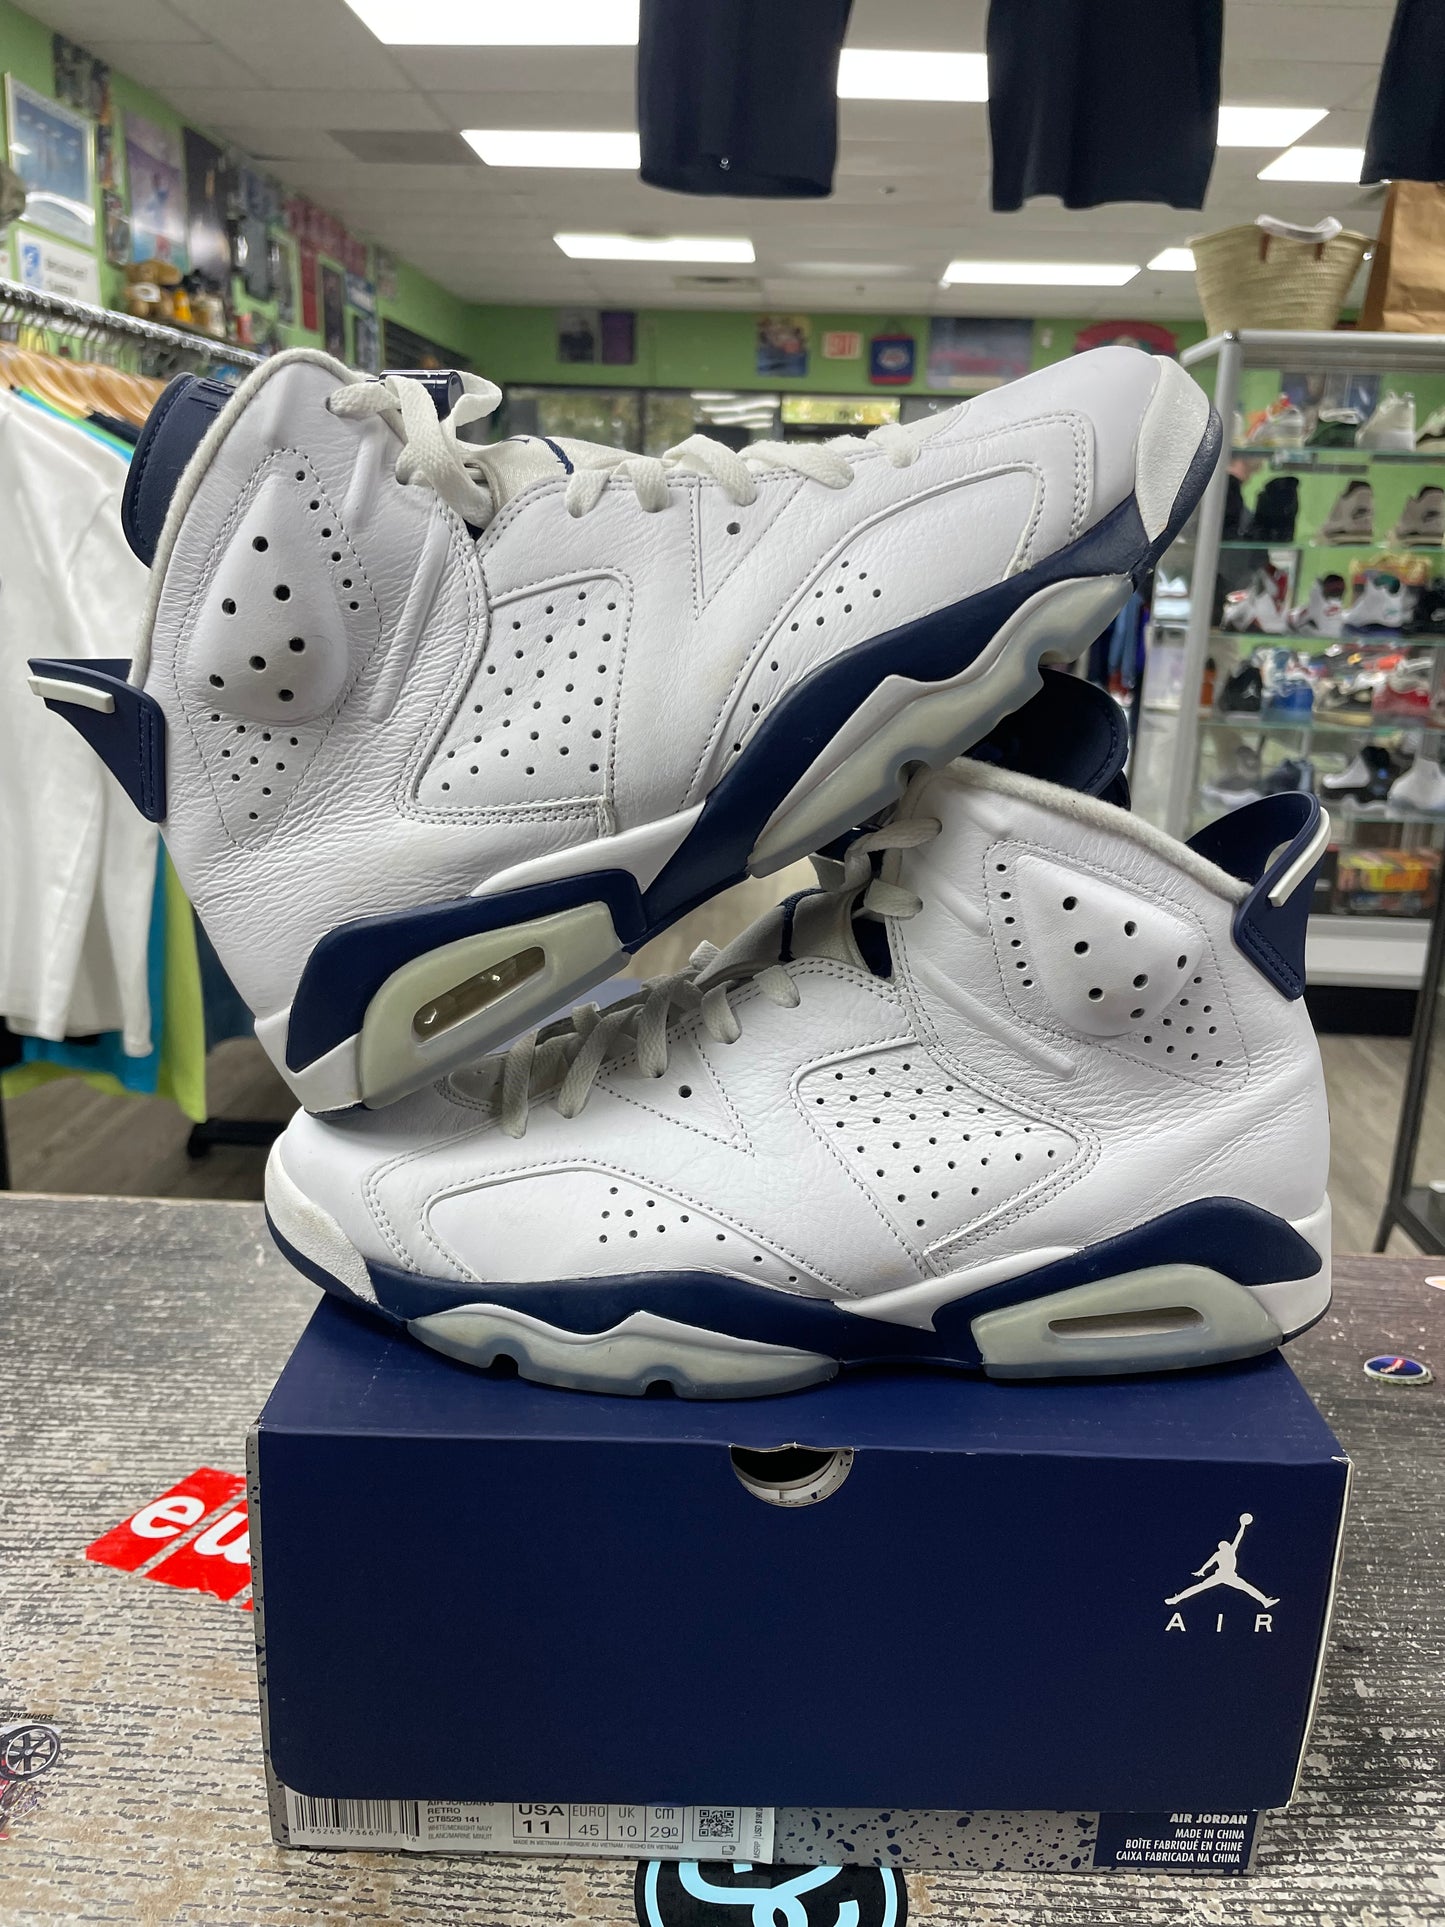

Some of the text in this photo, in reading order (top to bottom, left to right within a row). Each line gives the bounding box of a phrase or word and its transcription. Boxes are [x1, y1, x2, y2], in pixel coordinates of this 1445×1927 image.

[1165, 1612, 1273, 1633] AIR
[427, 1807, 461, 1815] RETRO
[518, 1804, 565, 1816] USA
[572, 1805, 606, 1818] EURO
[618, 1807, 635, 1819] UK
[655, 1808, 674, 1820] cm
[427, 1815, 462, 1823] CT8529
[1169, 1813, 1248, 1825] AIR JORDAN
[522, 1820, 550, 1834] 11
[578, 1824, 600, 1836] 45
[617, 1825, 637, 1837] 10
[1175, 1828, 1245, 1840] MADE IN CHINA
[1125, 1837, 1152, 1850] BOÎTE
[1200, 1841, 1212, 1851] EN
[1215, 1841, 1243, 1852] CHINE
[1115, 1850, 1240, 1864] CAIXA FABRICADA NA CHINA
